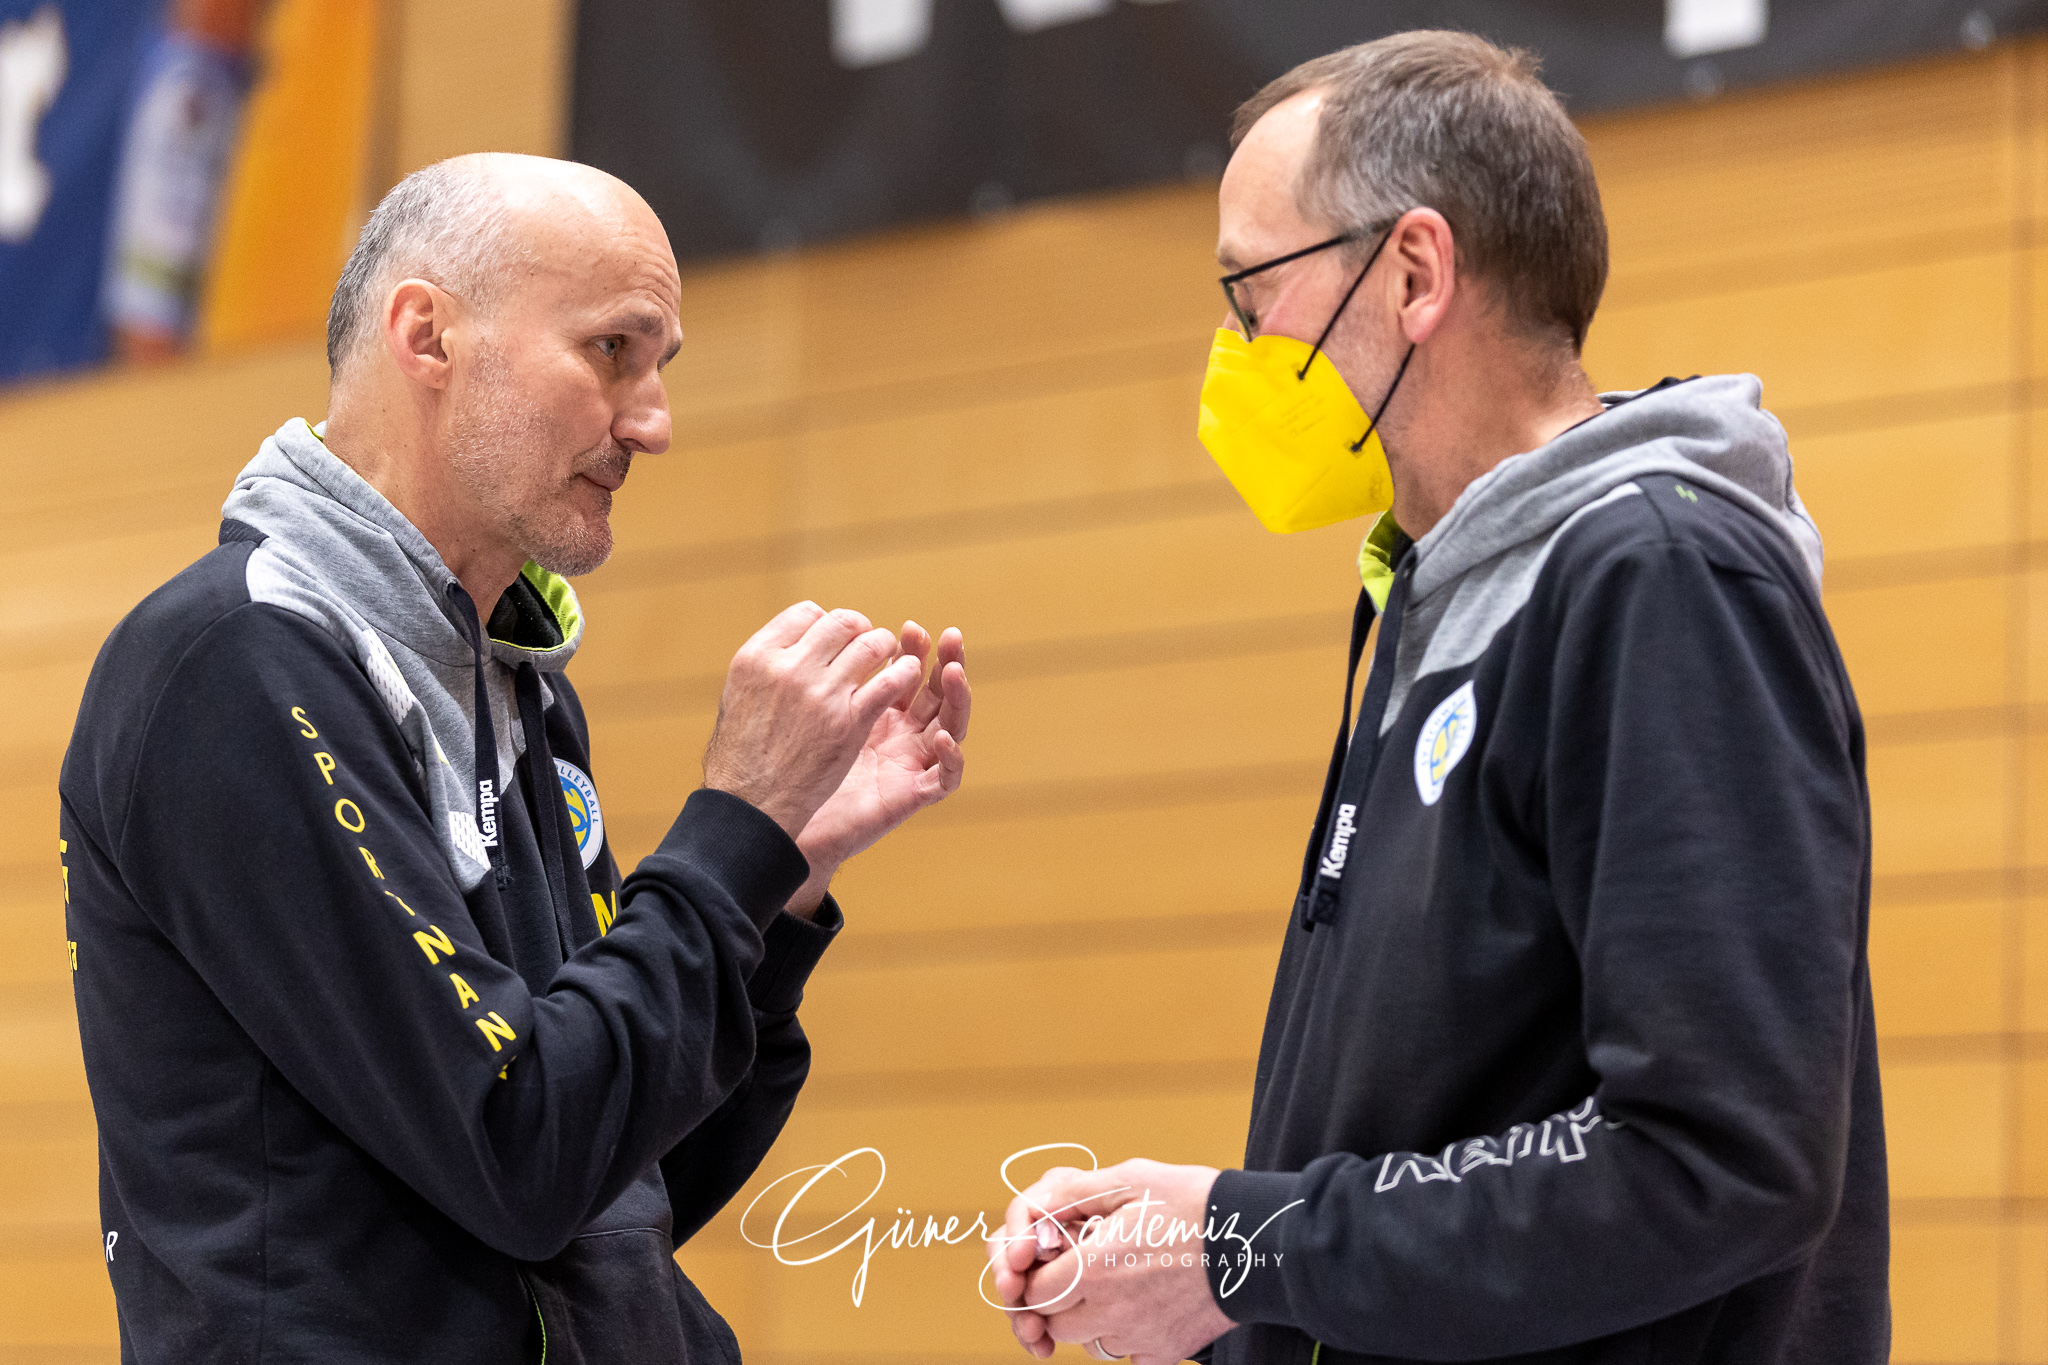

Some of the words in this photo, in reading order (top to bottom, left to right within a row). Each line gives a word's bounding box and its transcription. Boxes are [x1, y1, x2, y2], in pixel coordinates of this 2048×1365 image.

[479, 779, 499, 847] Kempa
[555, 764, 599, 824] LLEYBALL
[1320, 803, 1357, 879] Kempa
